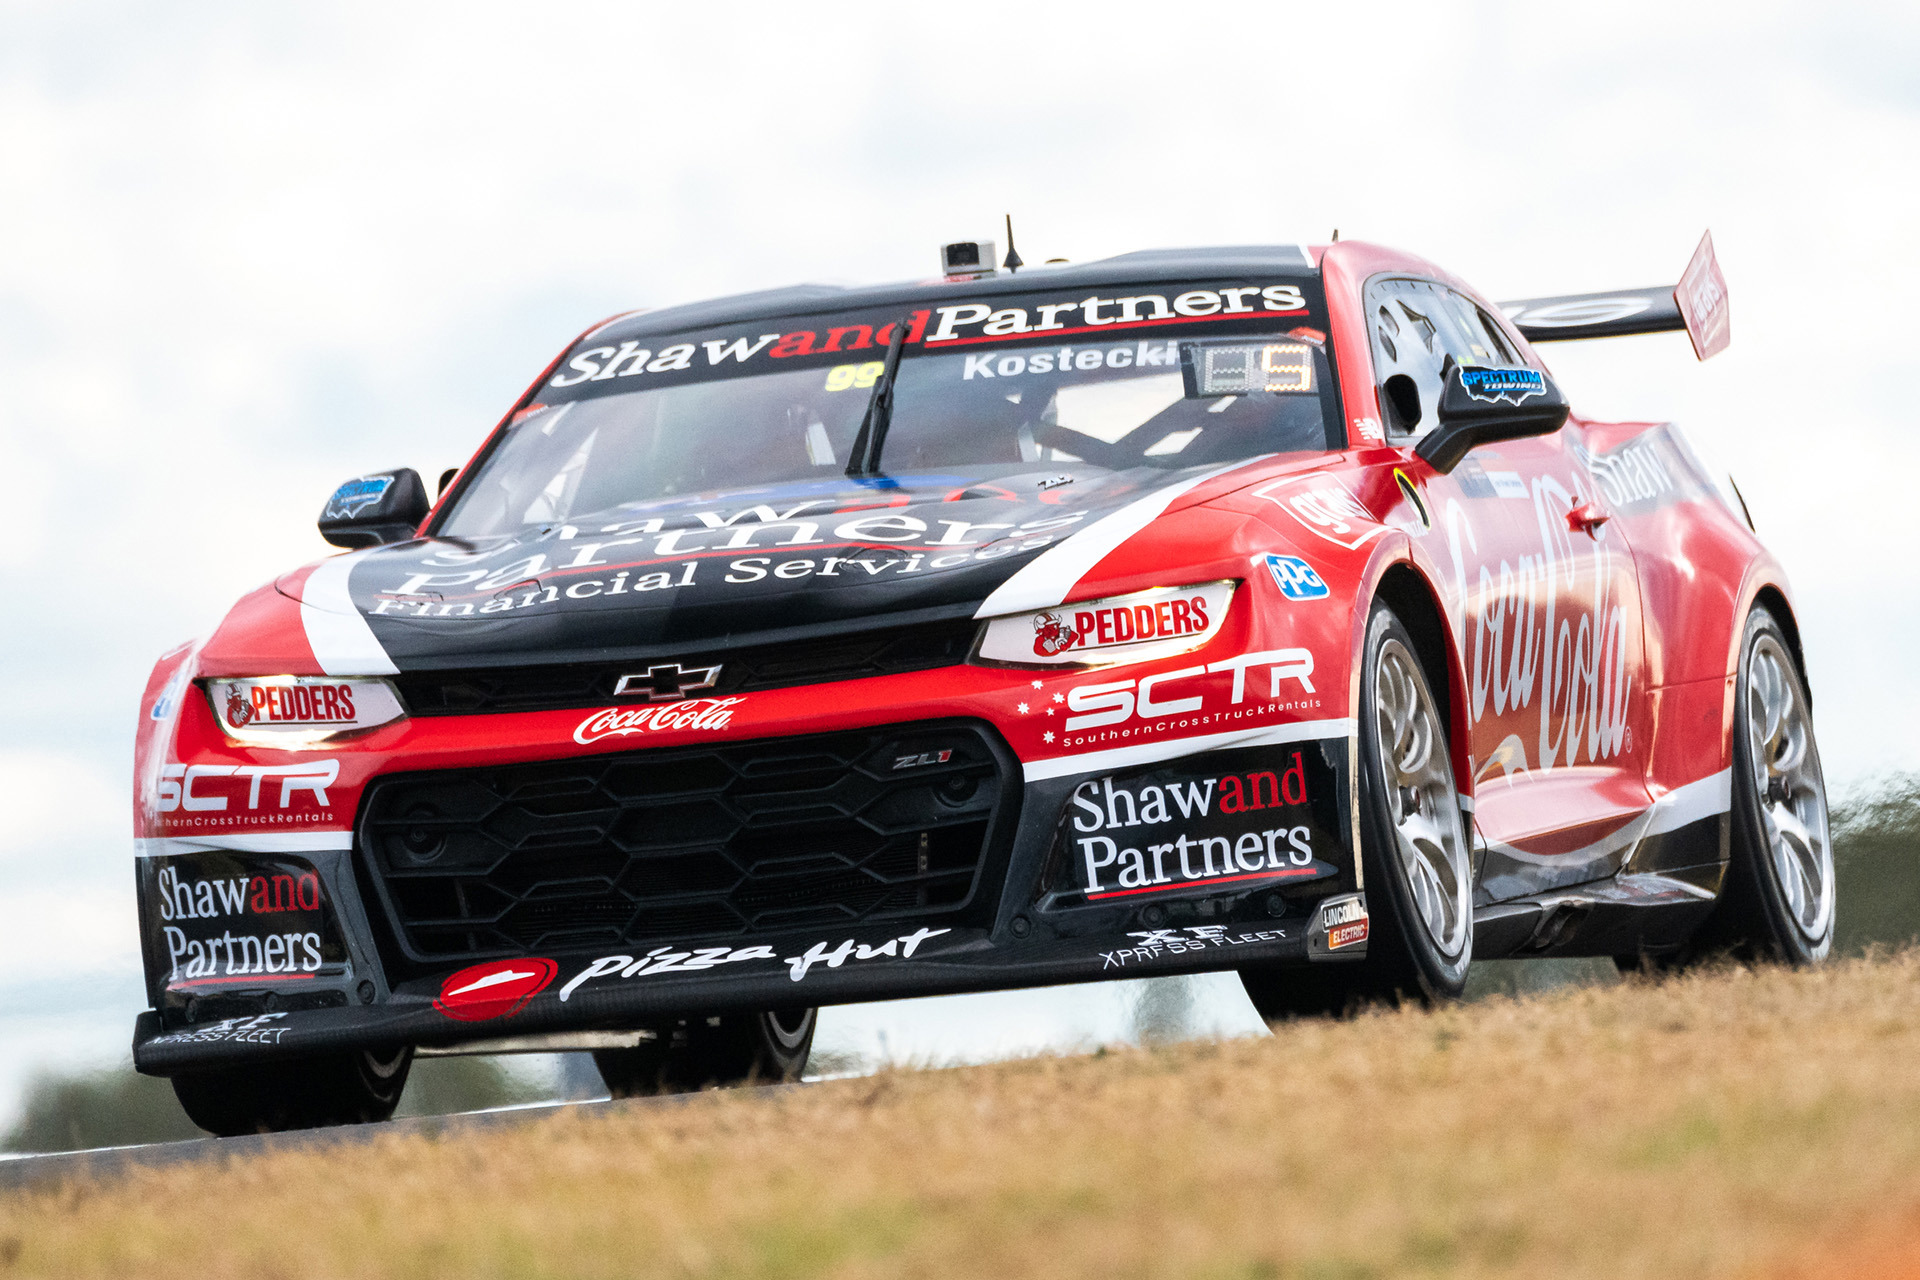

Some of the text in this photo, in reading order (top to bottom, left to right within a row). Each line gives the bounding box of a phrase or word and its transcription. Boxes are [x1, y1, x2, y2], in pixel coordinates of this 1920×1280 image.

[825, 361, 884, 391] 99
[963, 340, 1178, 380] Kostecki
[1462, 370, 1541, 386] SPECTRUM
[382, 510, 1088, 597] Partners
[368, 535, 1053, 616] Financial Services
[1270, 559, 1323, 596] PPG
[1074, 596, 1210, 647] PEDDERS
[251, 684, 356, 721] PEDDERS
[1065, 648, 1317, 732] SCTR
[892, 749, 952, 770] ZL1
[152, 758, 340, 812] SCTR
[1077, 825, 1314, 894] Partners
[1210, 929, 1287, 947] FLEET
[1333, 924, 1365, 943] ELECTRIC
[163, 926, 322, 982] Partners
[784, 928, 951, 982] Hut
[225, 1027, 292, 1045] FLEET
